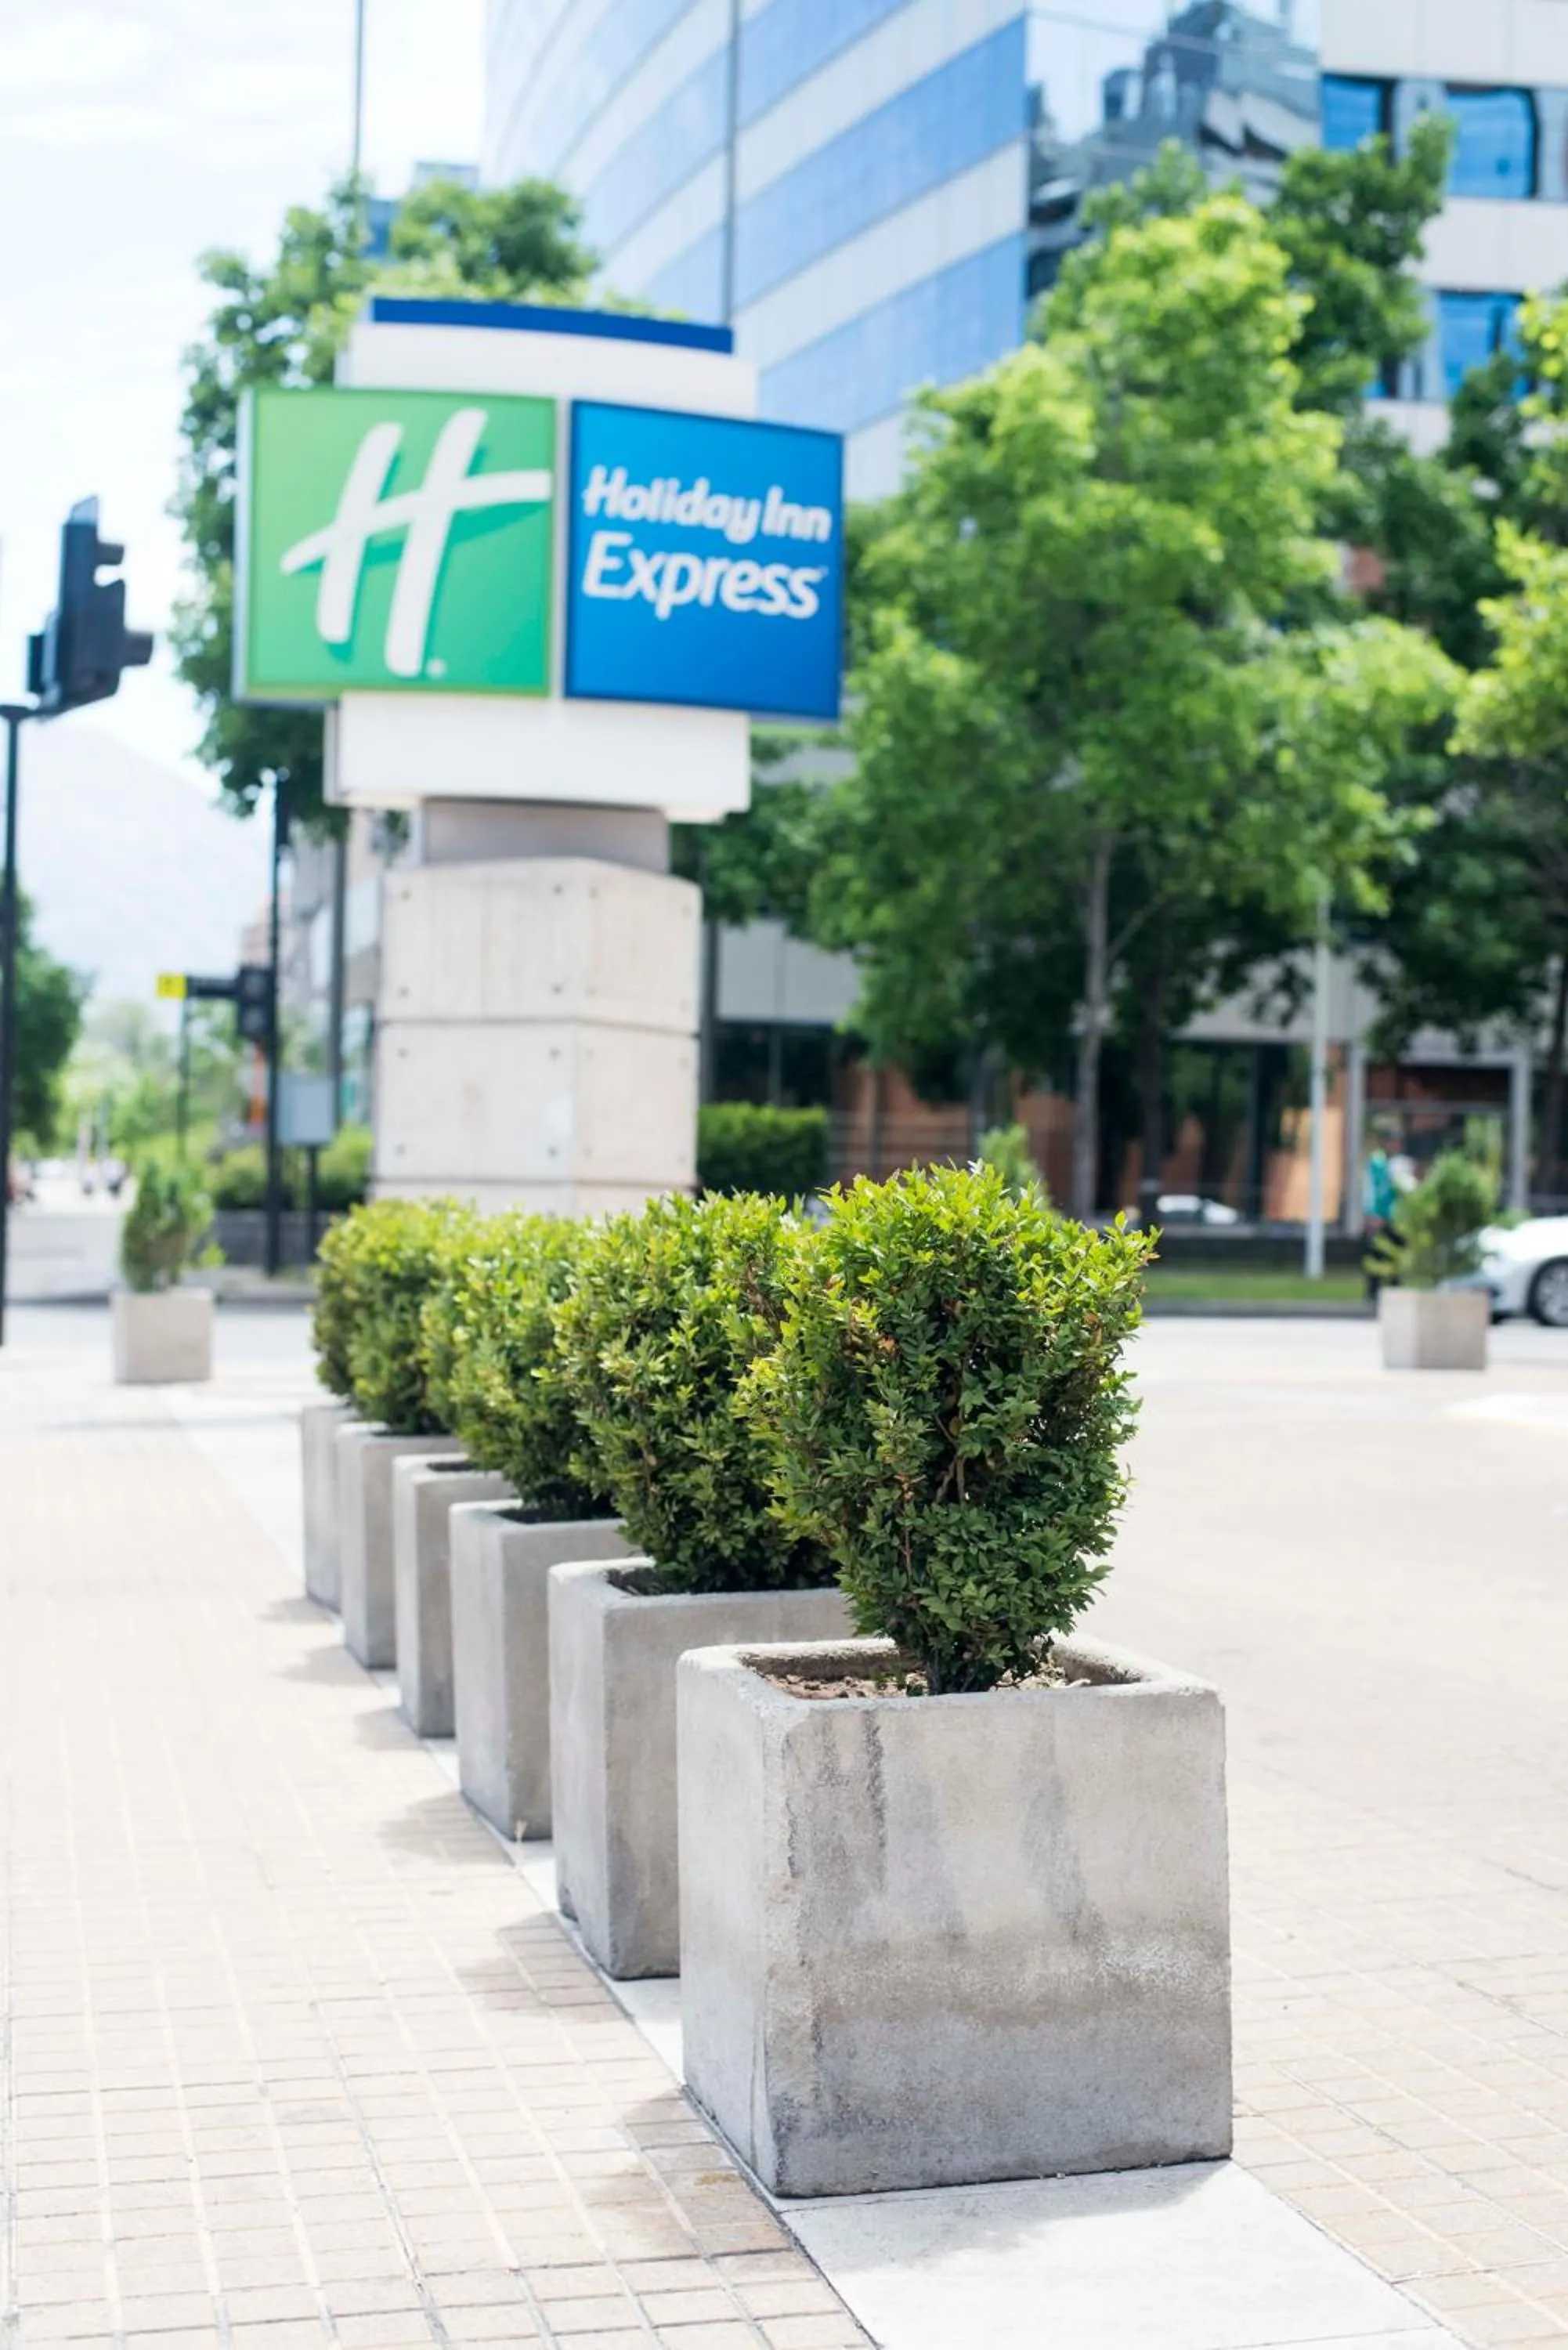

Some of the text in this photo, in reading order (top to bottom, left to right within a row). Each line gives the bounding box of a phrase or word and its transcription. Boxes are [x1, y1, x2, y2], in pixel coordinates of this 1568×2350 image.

[279, 407, 551, 678] H
[583, 465, 831, 544] Holiday Inn
[583, 530, 821, 620] Express
